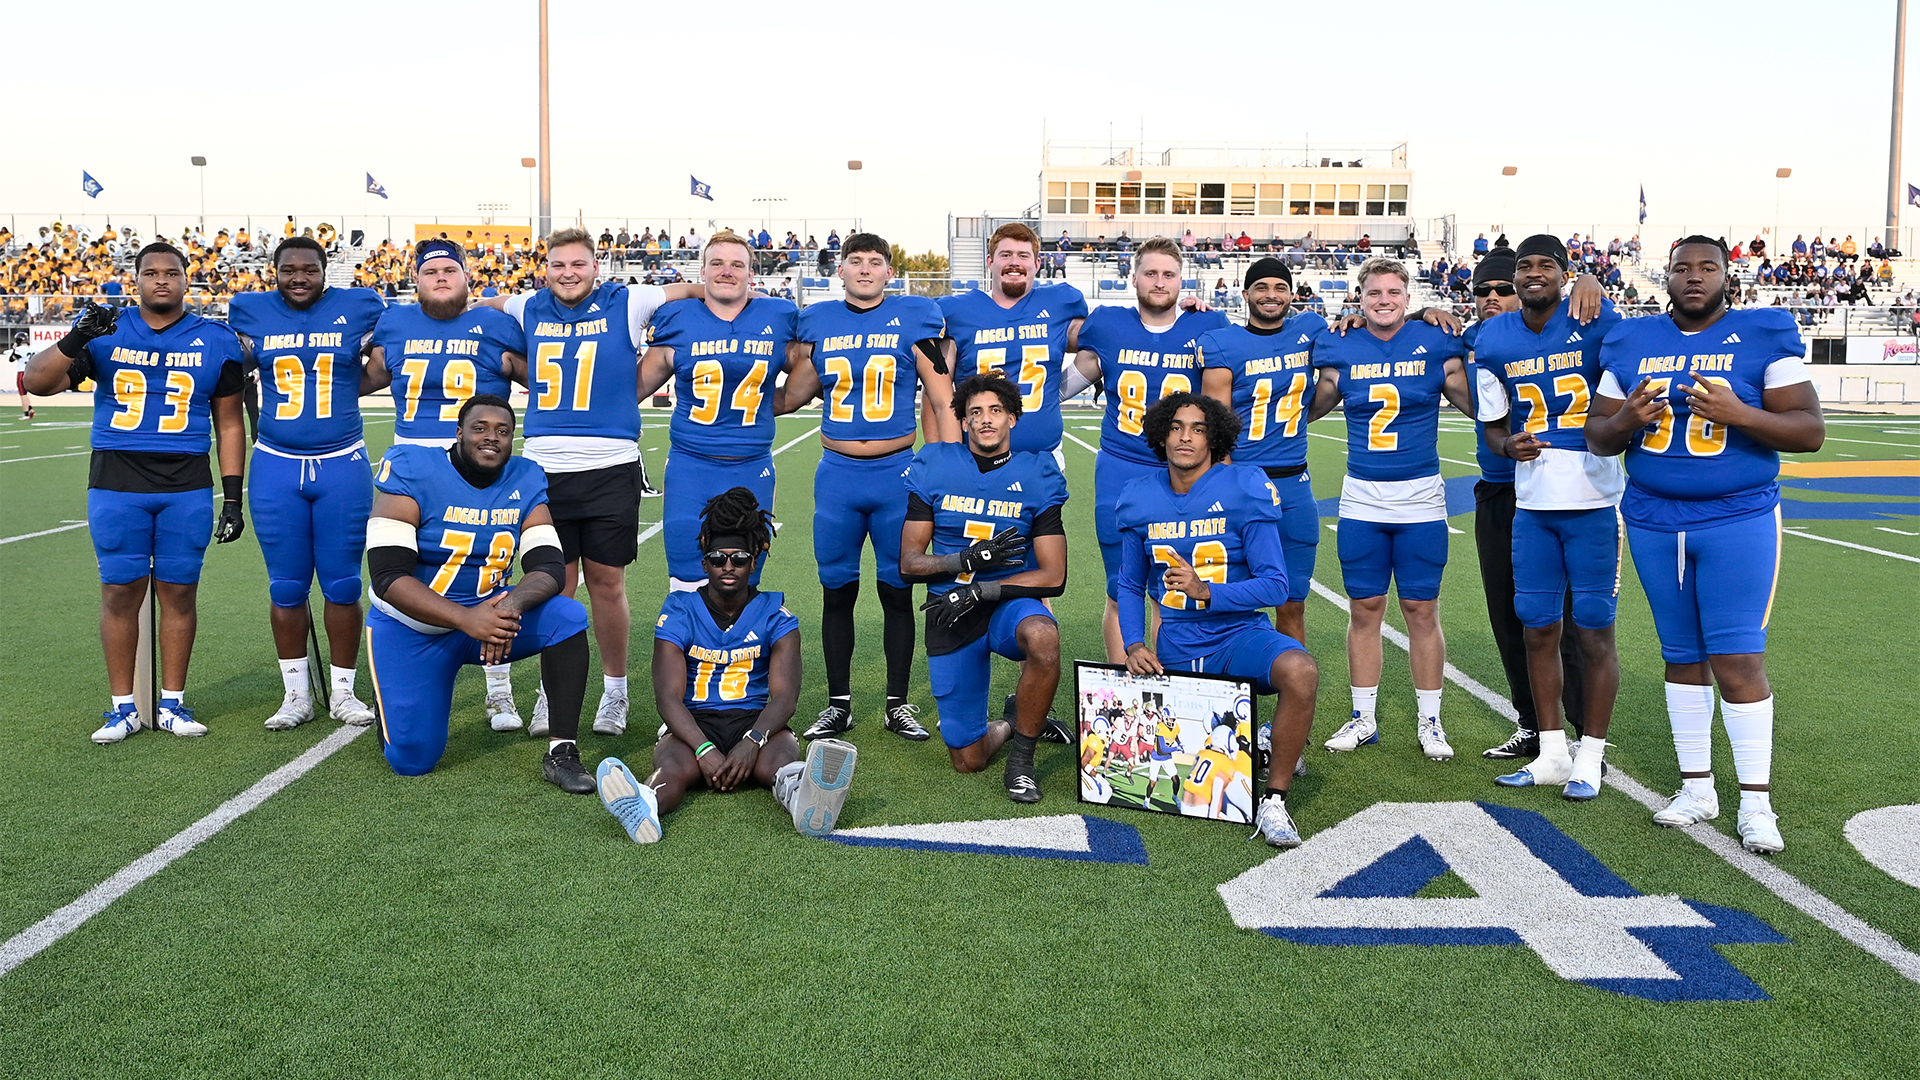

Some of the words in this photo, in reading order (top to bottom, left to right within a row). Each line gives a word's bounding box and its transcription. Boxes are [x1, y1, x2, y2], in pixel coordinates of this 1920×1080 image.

[708, 219, 716, 228] K
[1491, 224, 1500, 233] M
[1762, 227, 1771, 235] N
[534, 322, 572, 337] ANGELO
[575, 318, 608, 336] STATE
[974, 326, 1014, 344] ANGELO
[1019, 324, 1048, 339] STATE
[263, 334, 304, 350] ANGELO
[309, 333, 342, 347] STATE
[404, 339, 443, 355] ANGELO
[446, 339, 479, 355] STATE
[691, 339, 738, 356] ANGELO
[744, 340, 774, 356] STATE
[823, 335, 862, 352] ANGELO
[866, 334, 899, 348] STATE
[111, 347, 159, 367] ANGELO
[165, 350, 202, 367] STATE
[1118, 349, 1158, 366] ANGELO
[1162, 351, 1194, 369] STATE
[1246, 356, 1283, 376] ANGELO
[1284, 351, 1309, 368] STATE
[1504, 357, 1545, 378] ANGELO
[1548, 351, 1583, 372] STATE
[1638, 355, 1686, 375] ANGELO
[1690, 354, 1734, 371] STATE
[536, 341, 598, 411] 51
[1351, 363, 1390, 380] ANGELO
[1394, 360, 1426, 377] STATE
[273, 353, 334, 420] 91
[401, 359, 477, 421] 79
[688, 359, 769, 426] 94
[824, 355, 897, 422] 20
[110, 369, 195, 433] 93
[1248, 373, 1308, 441] 14
[1368, 383, 1400, 451] 2
[443, 505, 488, 525] ANGELO
[490, 508, 521, 525] STATE
[941, 494, 985, 515] ANGELO
[987, 500, 1023, 518] STATE
[1148, 521, 1186, 540] ANGELO
[1190, 518, 1226, 537] STATE
[429, 528, 515, 598] 78
[688, 645, 728, 665] ANGELO
[731, 645, 761, 663] STATE
[691, 659, 754, 701] 16
[1119, 733, 1127, 743] 5
[1145, 724, 1155, 735] 81
